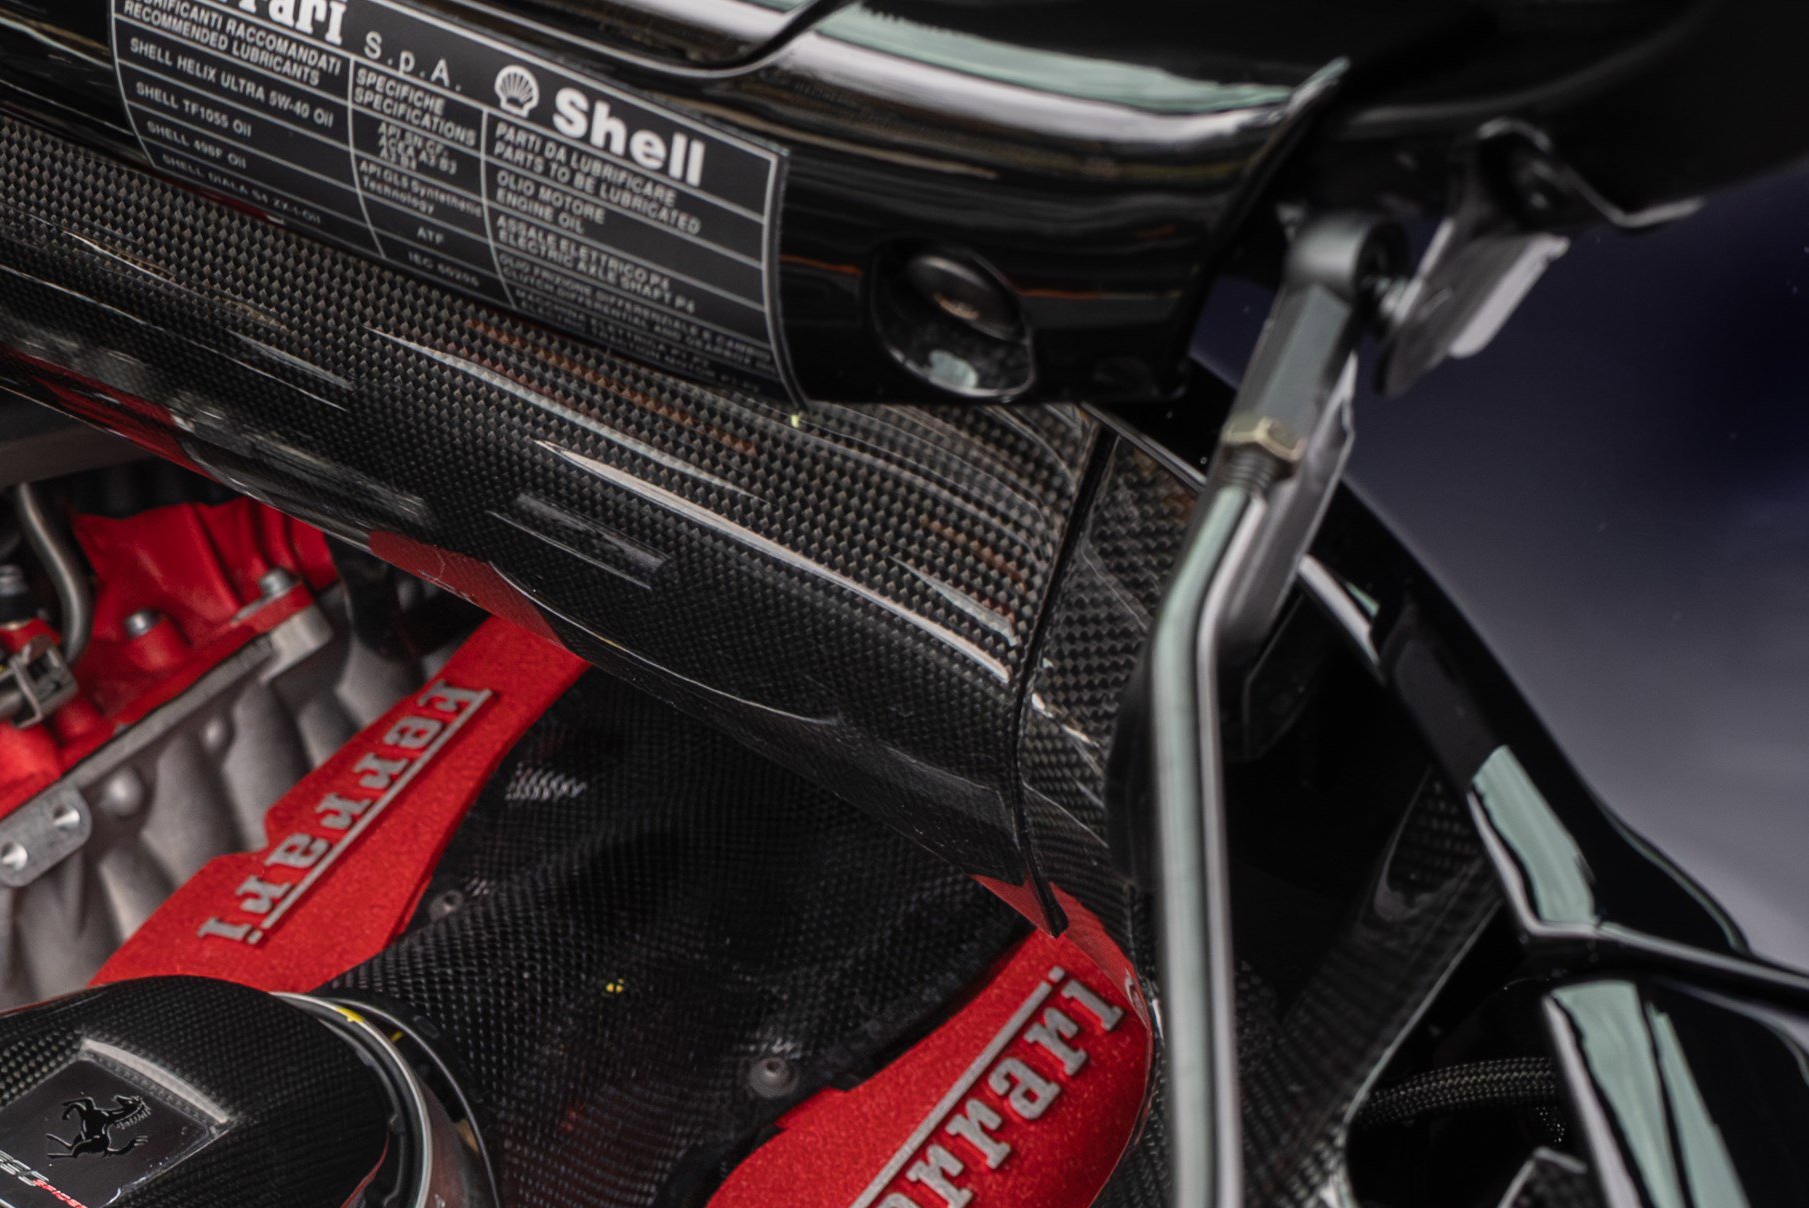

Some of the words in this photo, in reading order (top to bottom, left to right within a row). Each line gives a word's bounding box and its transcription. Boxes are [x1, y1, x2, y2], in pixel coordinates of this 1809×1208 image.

[124, 0, 228, 50] RECOMMENDED
[231, 41, 320, 87] LUBRICANTS
[130, 37, 172, 66] SHELL
[176, 53, 217, 82] HELIX
[220, 72, 265, 102] ULTRA
[225, 17, 341, 76] RACCOMANDATI
[136, 82, 179, 109] SHELL
[354, 86, 477, 147] SPECIFICATIONS
[356, 68, 446, 116] SPECIFICHE
[147, 121, 190, 146] SHELL
[496, 121, 542, 152] PARTI
[545, 141, 567, 163] DA
[571, 152, 677, 207] LUBRIFICARE
[553, 88, 705, 187] Shell
[494, 142, 544, 174] PARTS
[550, 164, 570, 183] TO
[574, 172, 596, 194] BE
[600, 182, 701, 236] LUBRICATED
[496, 189, 554, 222] ENGINE
[558, 211, 585, 235] OIL
[497, 170, 535, 195] OLIO
[538, 185, 606, 225] MOTORE
[198, 679, 494, 945] Ferrari
